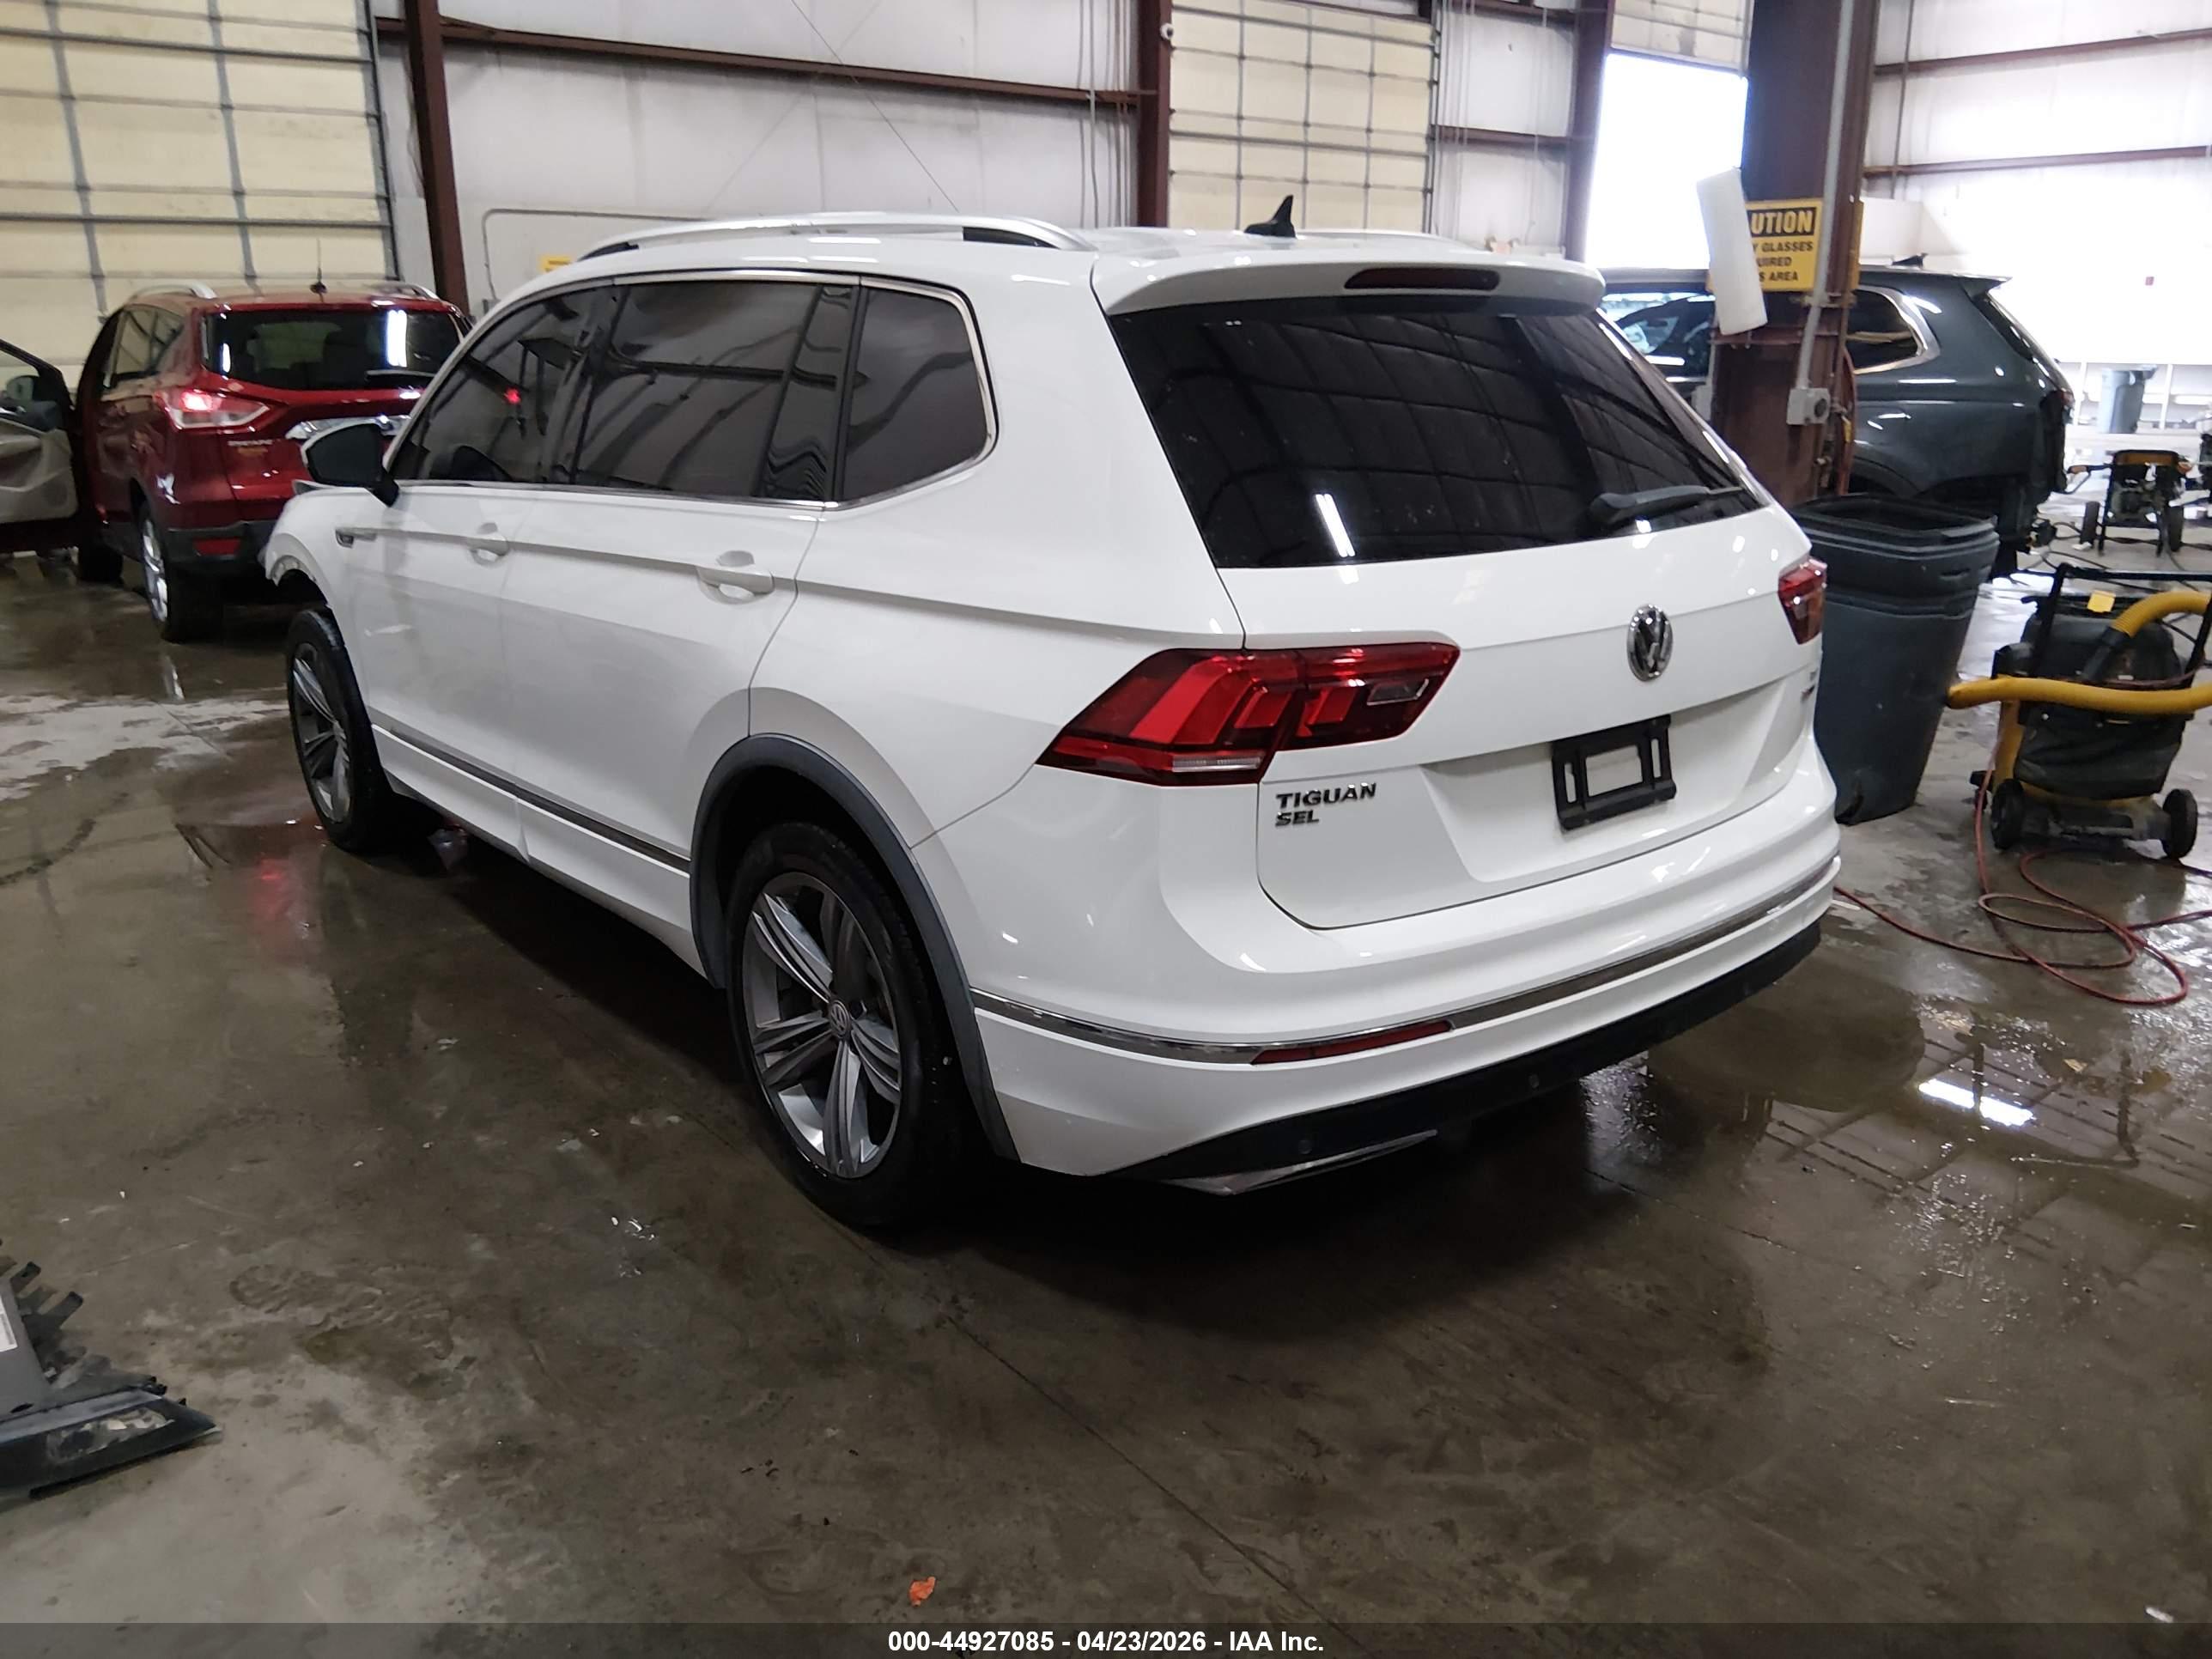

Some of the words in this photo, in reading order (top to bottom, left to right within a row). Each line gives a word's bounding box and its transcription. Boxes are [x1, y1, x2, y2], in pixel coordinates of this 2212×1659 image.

[1751, 210, 1814, 234] UTION
[1761, 241, 1814, 252] GLASSES
[1756, 256, 1792, 267] UIRED
[1768, 270, 1799, 282] AREA
[1275, 782, 1377, 809] TIGUAN
[1274, 810, 1320, 827] SEL
